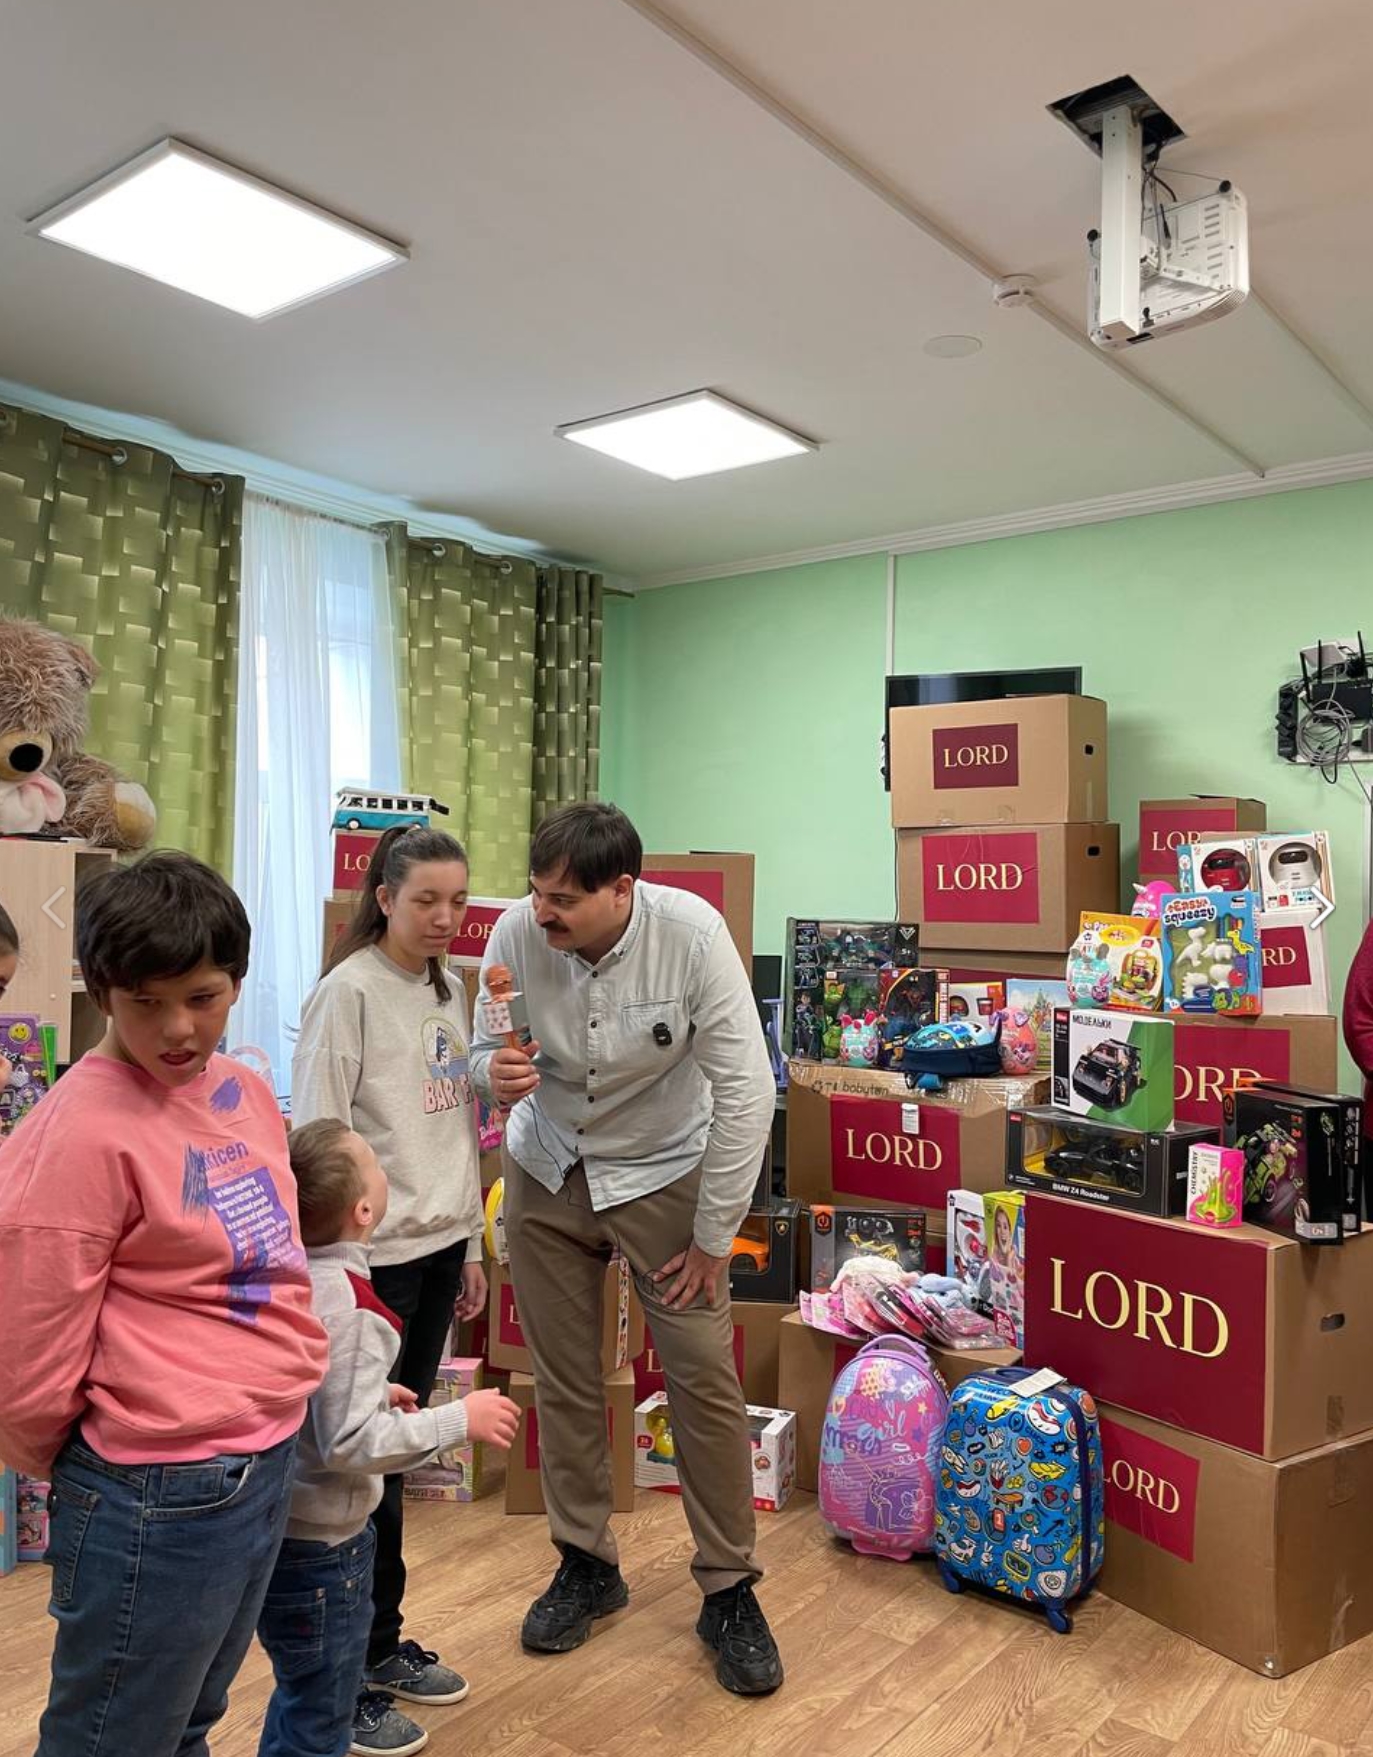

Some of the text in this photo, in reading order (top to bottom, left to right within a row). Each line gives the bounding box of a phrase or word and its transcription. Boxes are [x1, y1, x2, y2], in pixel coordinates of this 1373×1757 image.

[943, 744, 1008, 768] LORD
[1152, 831, 1201, 851] LOR
[345, 852, 372, 871] LO
[937, 863, 1022, 891] LORD
[456, 923, 494, 939] LOR
[1262, 946, 1297, 966] RD
[1174, 1065, 1262, 1102] OR
[846, 1128, 942, 1171] LORD
[1052, 1183, 1070, 1193] BMW
[1080, 1188, 1110, 1201] Roadster
[1050, 1257, 1229, 1358] LORD
[1104, 1460, 1180, 1514] ORD
